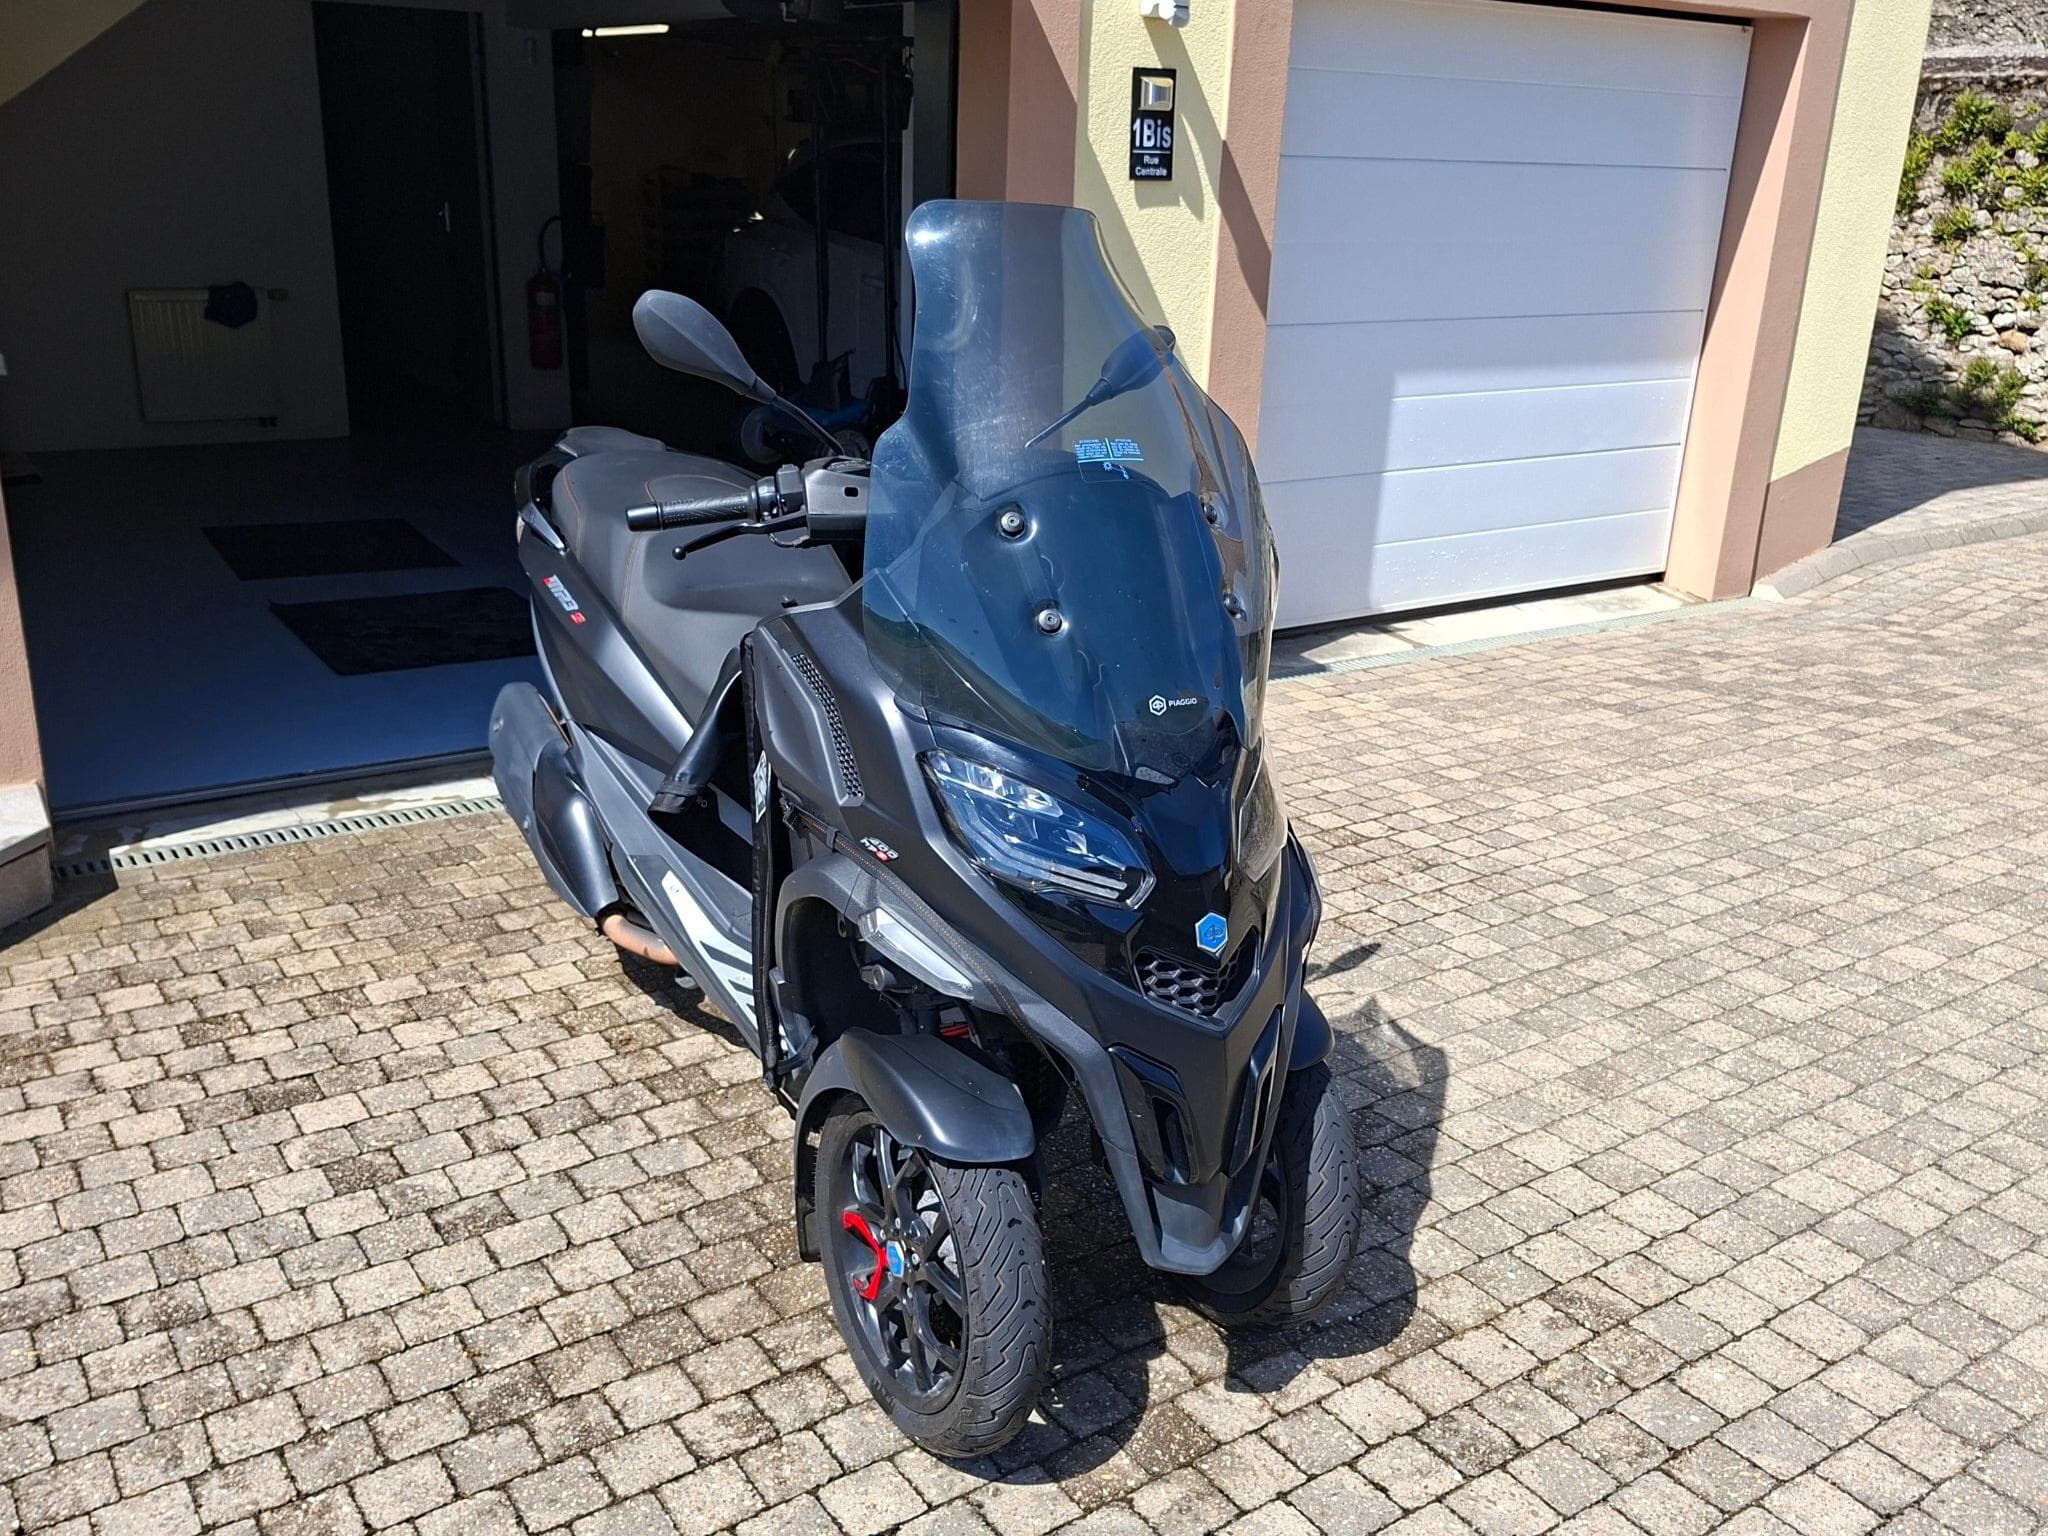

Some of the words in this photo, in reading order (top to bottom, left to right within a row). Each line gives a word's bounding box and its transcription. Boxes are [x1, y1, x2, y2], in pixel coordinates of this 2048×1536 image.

[1133, 117, 1172, 149] 1Bis
[1143, 155, 1160, 165] Rue
[1135, 166, 1168, 177] Centrale
[1168, 697, 1198, 708] PIAGGIO
